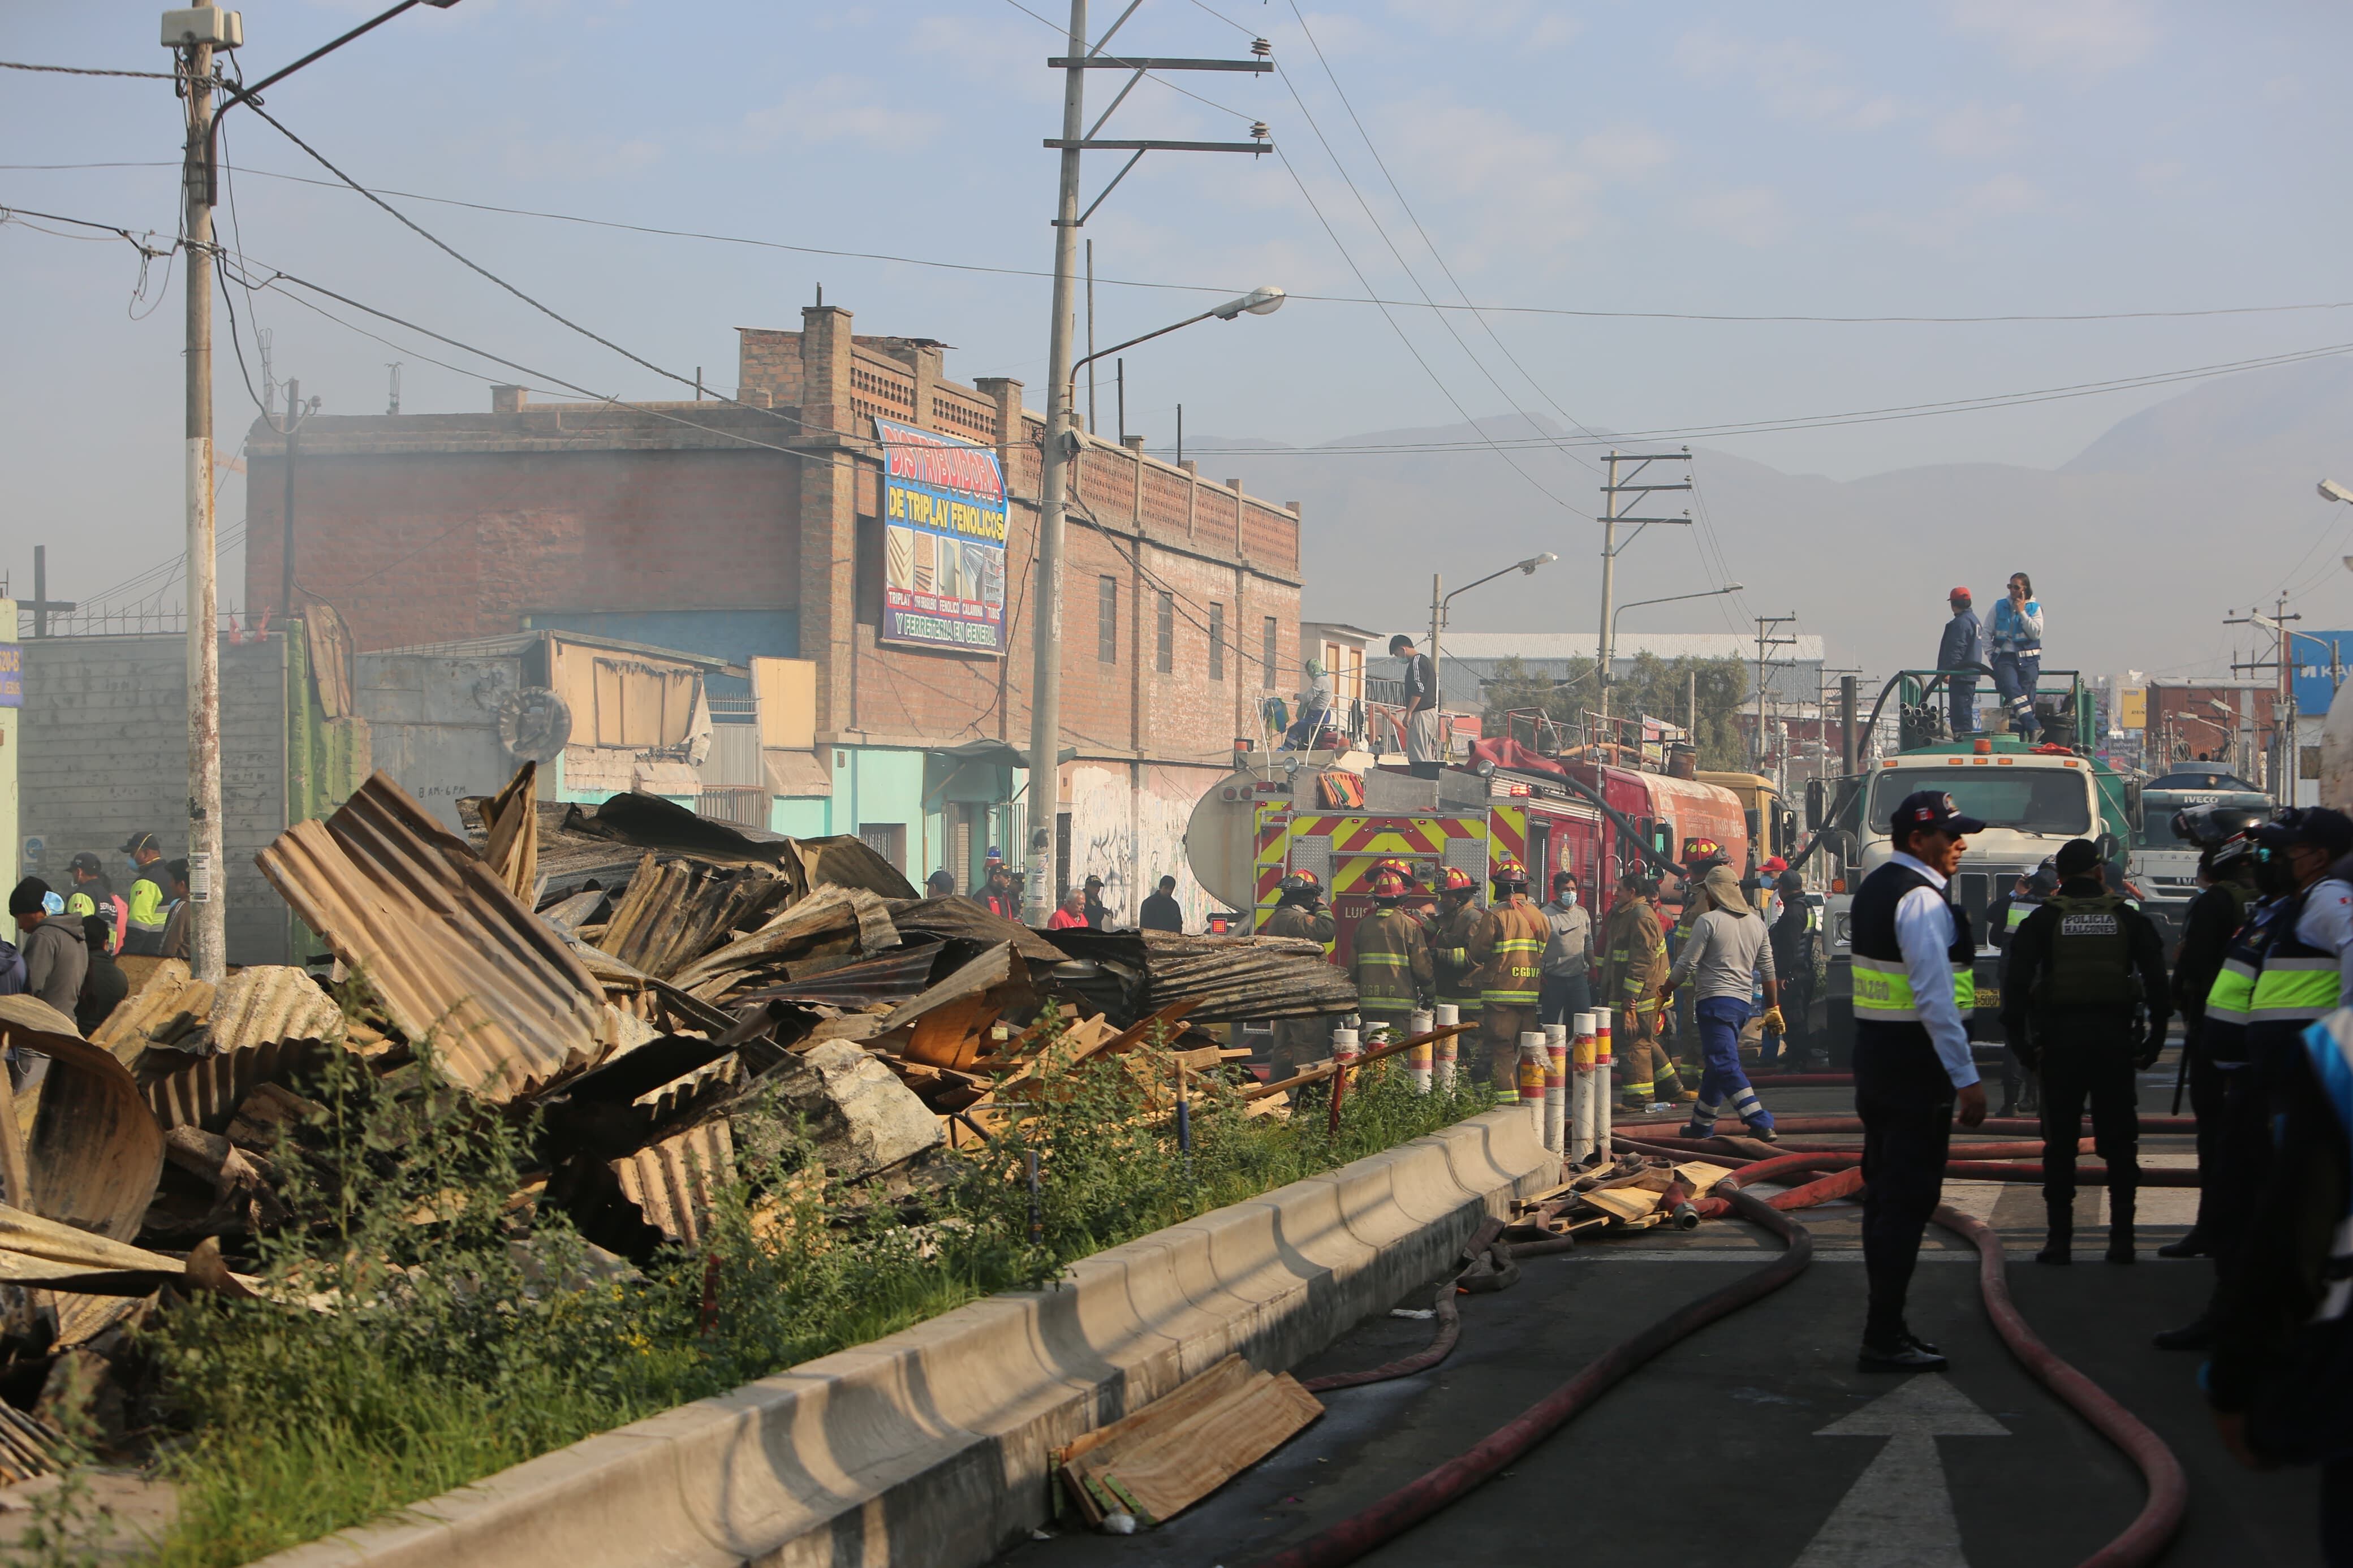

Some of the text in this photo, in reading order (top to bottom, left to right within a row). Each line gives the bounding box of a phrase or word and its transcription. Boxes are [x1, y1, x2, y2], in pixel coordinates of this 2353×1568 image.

[883, 425, 1002, 503] DISTRIBUIDORA
[889, 486, 1005, 541] DE TRIPLAY FENOLICOS
[889, 591, 911, 607] TRIPLAY
[940, 599, 960, 614] FENOLICO
[962, 602, 983, 617] CALAMINA
[895, 612, 997, 646] Y FERRETERIA EN GENERAL
[2065, 915, 2114, 924] POLICIA
[2063, 925, 2117, 934] HALCONES
[1512, 966, 1540, 978] CGBVP
